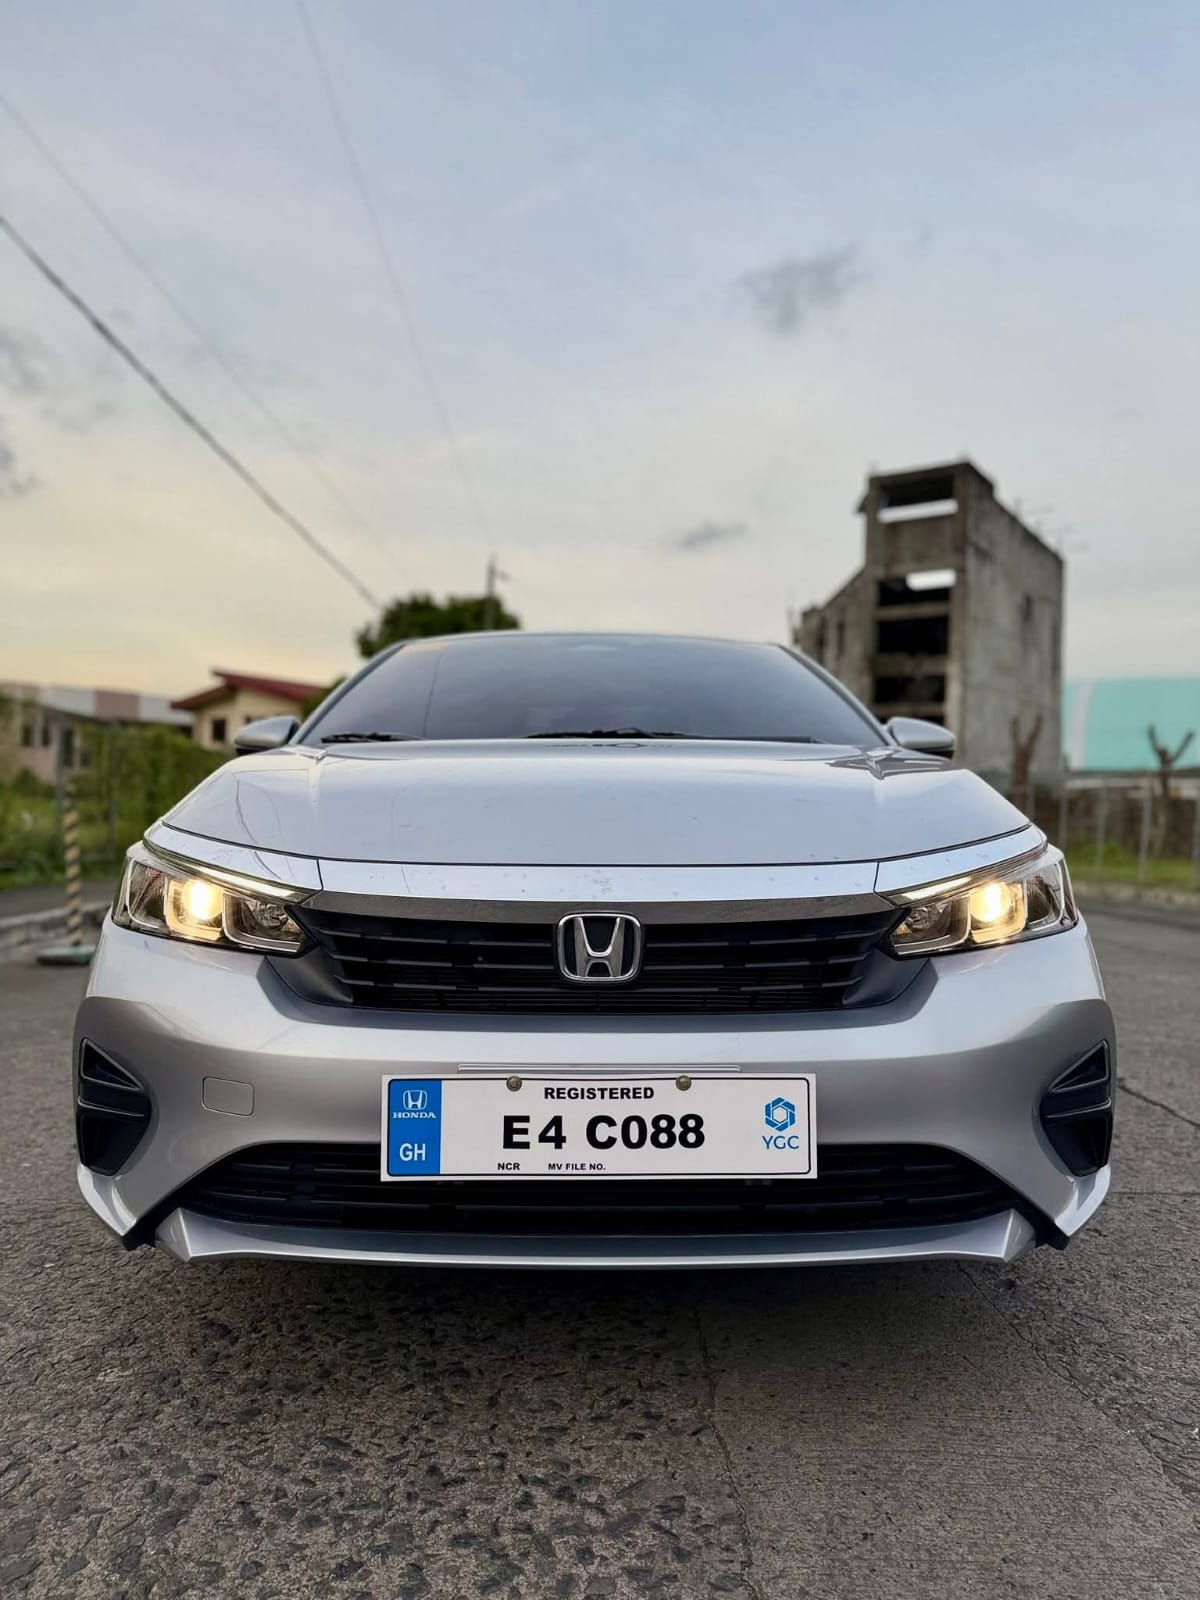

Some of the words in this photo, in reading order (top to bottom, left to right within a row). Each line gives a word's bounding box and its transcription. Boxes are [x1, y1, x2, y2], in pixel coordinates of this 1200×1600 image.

[544, 1086, 655, 1100] REGISTERED
[502, 1115, 567, 1150] E4
[585, 1113, 705, 1150] C088
[761, 1135, 800, 1150] YGC
[399, 1143, 426, 1161] GH
[497, 1162, 521, 1171] NCR
[548, 1162, 563, 1171] MV
[565, 1162, 587, 1171] FILE
[589, 1162, 606, 1171] NO.
